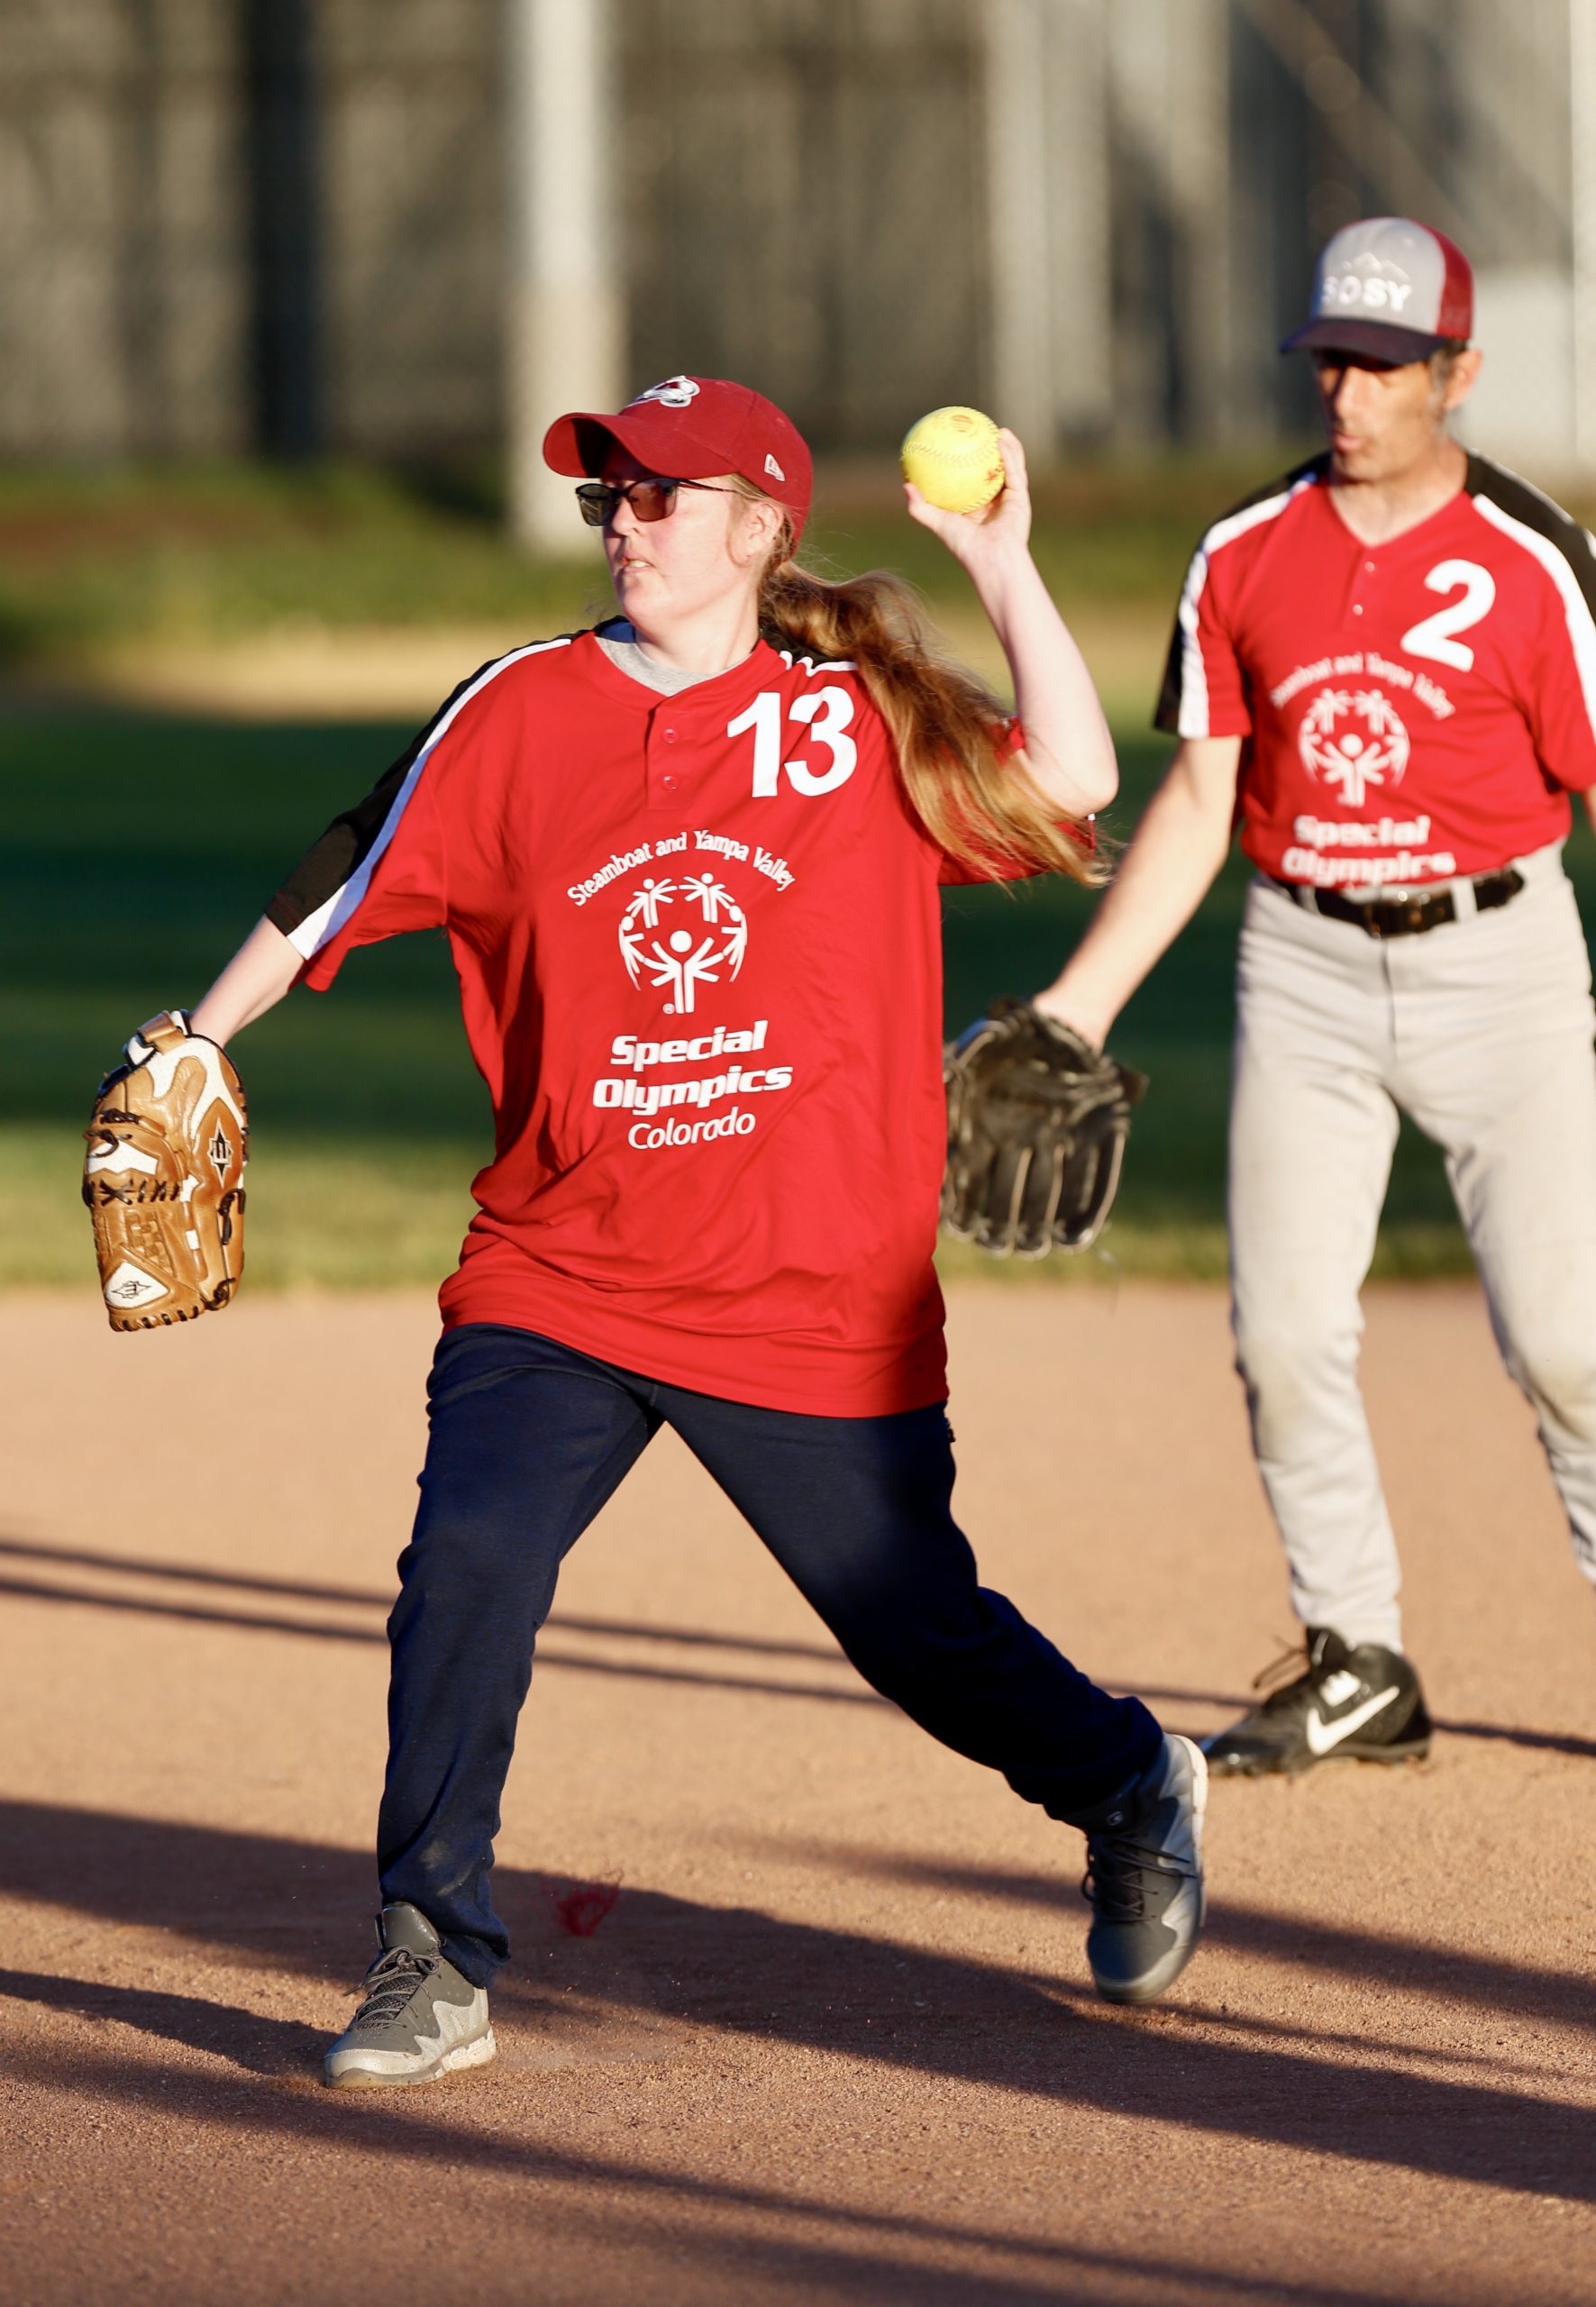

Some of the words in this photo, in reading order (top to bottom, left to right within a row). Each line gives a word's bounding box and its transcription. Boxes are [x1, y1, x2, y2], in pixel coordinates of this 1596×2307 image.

[1400, 559, 1496, 672] 2
[726, 686, 858, 798] 13
[1295, 815, 1431, 850] Special
[567, 843, 654, 907] Steamboat
[655, 831, 688, 857] and
[693, 829, 750, 862] Yampa
[752, 846, 796, 892] Valley
[610, 1019, 769, 1072] Special
[592, 1065, 794, 1117] Olympics
[627, 1106, 756, 1150] Colorado
